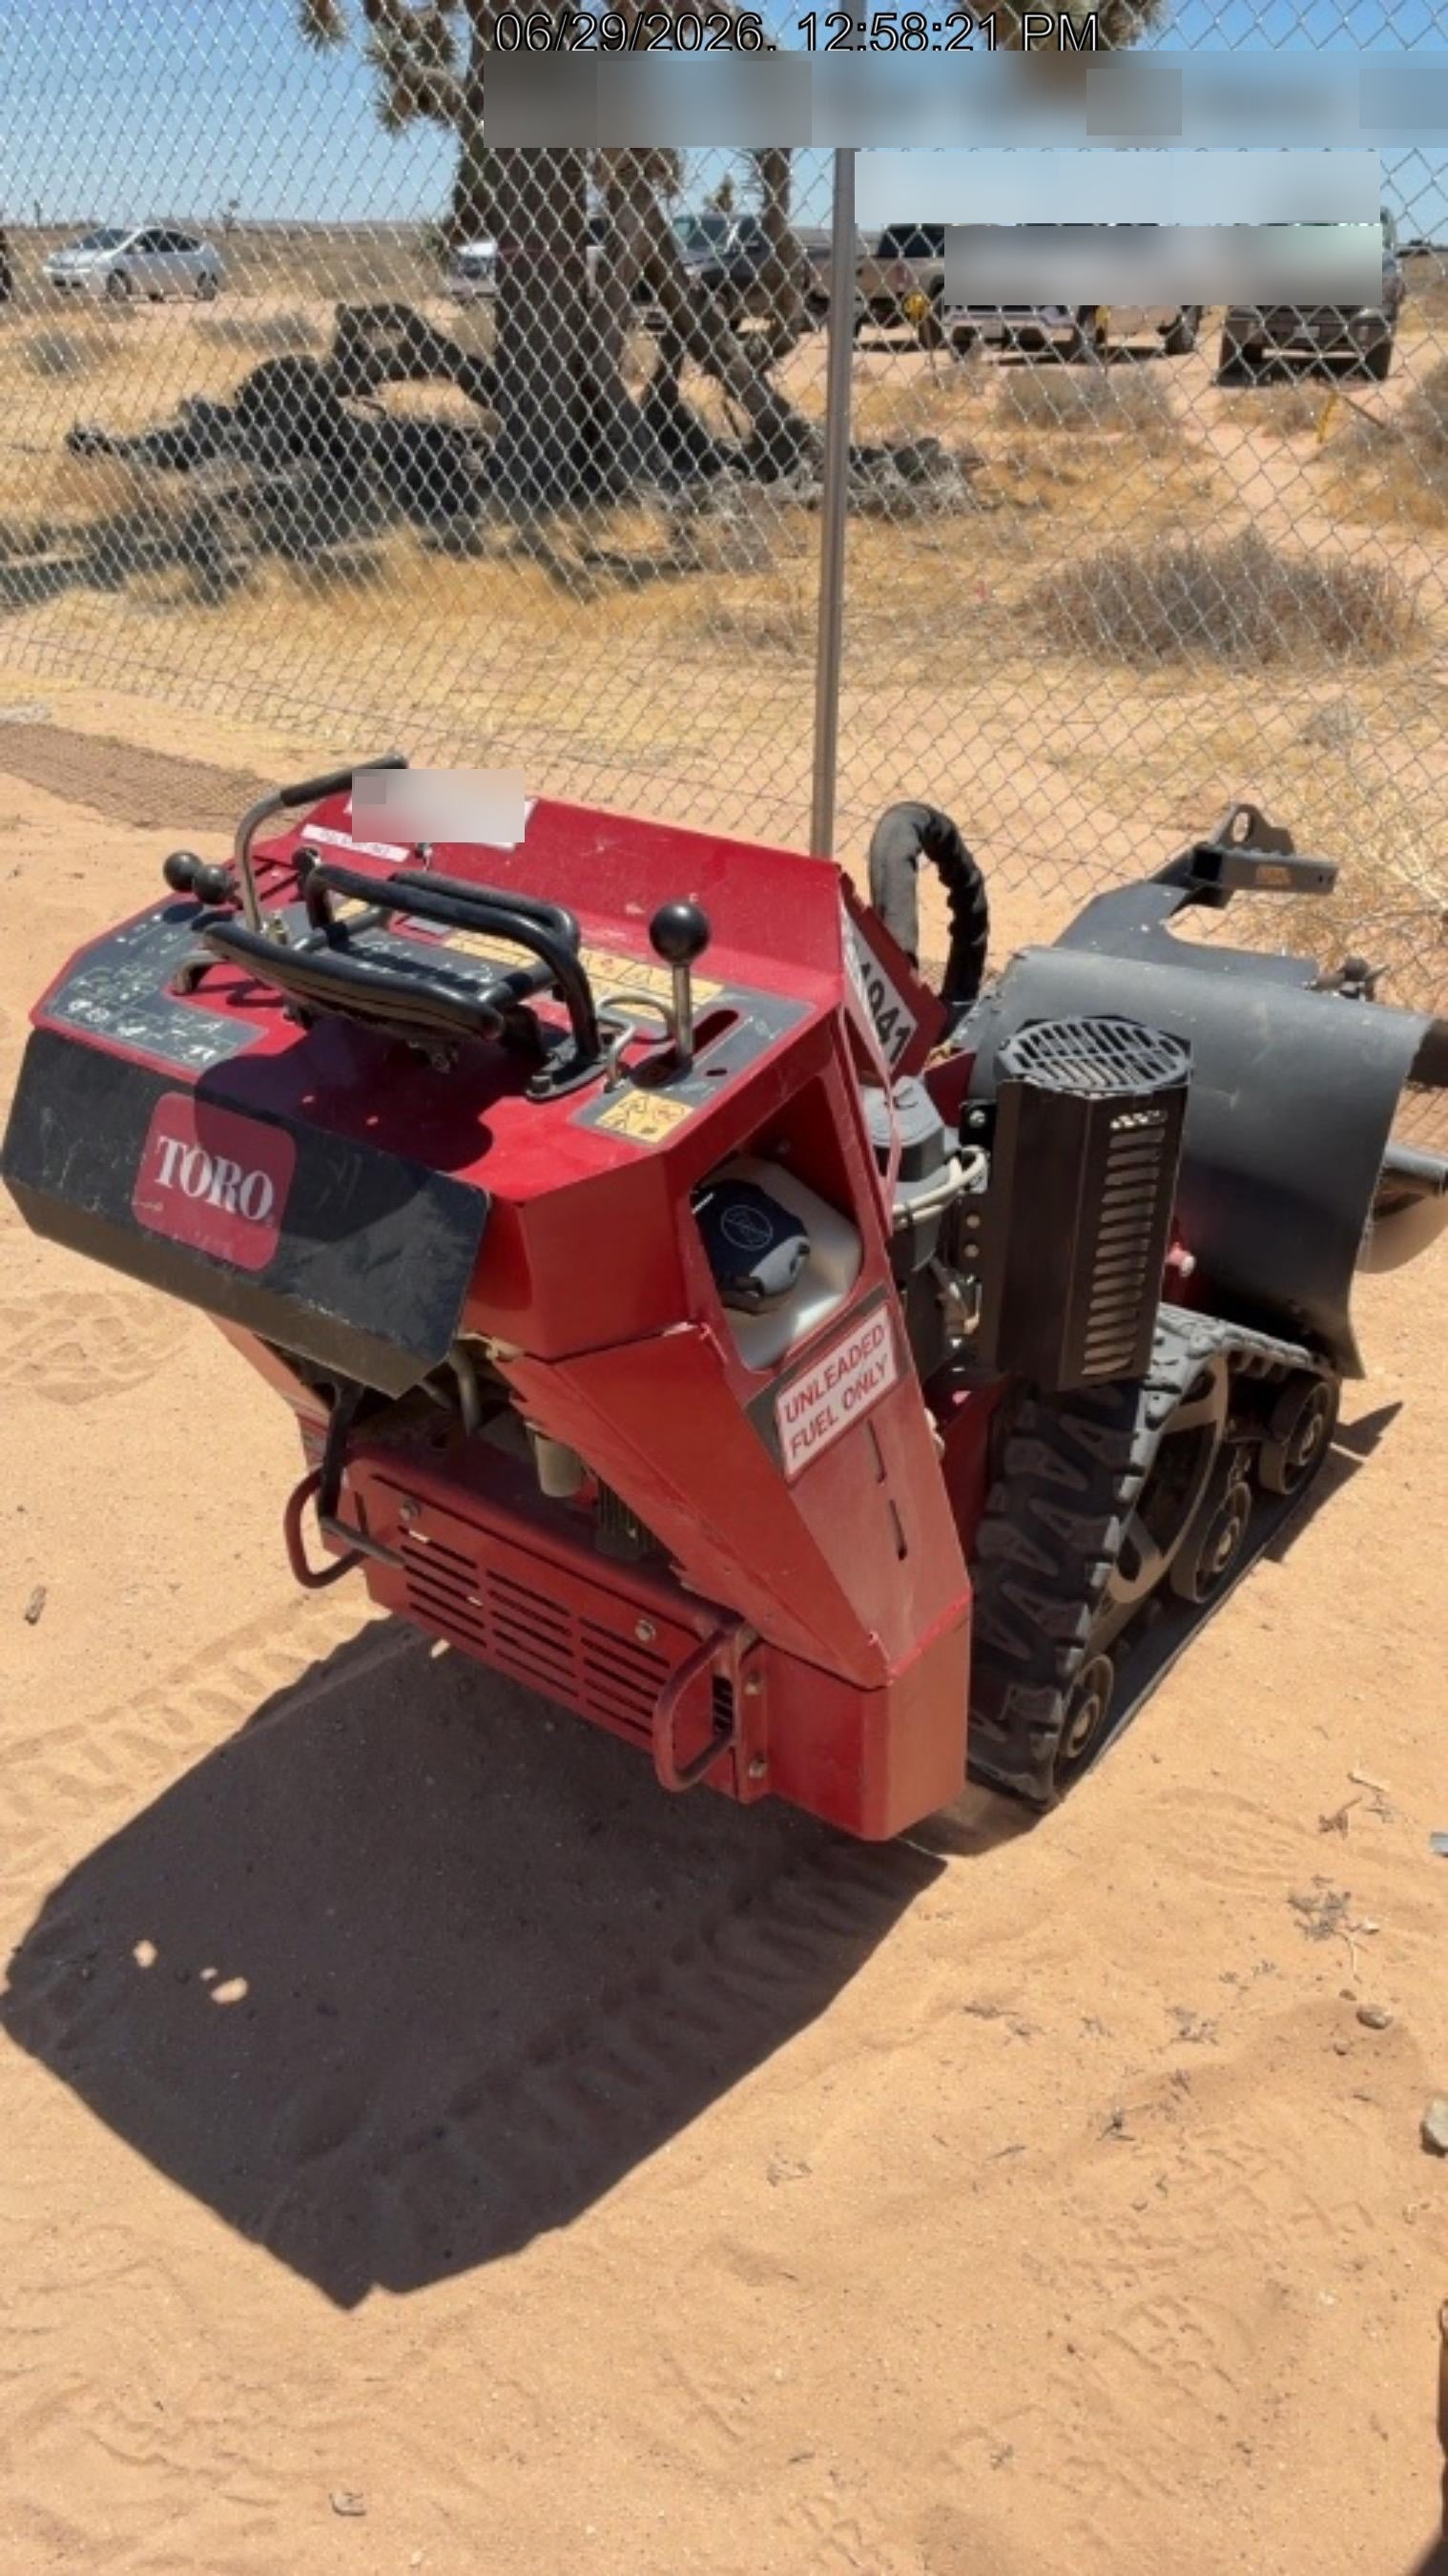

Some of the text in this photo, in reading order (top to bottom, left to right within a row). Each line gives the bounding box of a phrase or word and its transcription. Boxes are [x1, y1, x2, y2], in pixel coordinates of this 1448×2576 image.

[155, 1135, 274, 1221] TORO
[785, 1323, 885, 1423] UNLEADED
[790, 1353, 888, 1458] FUEL ONLY
